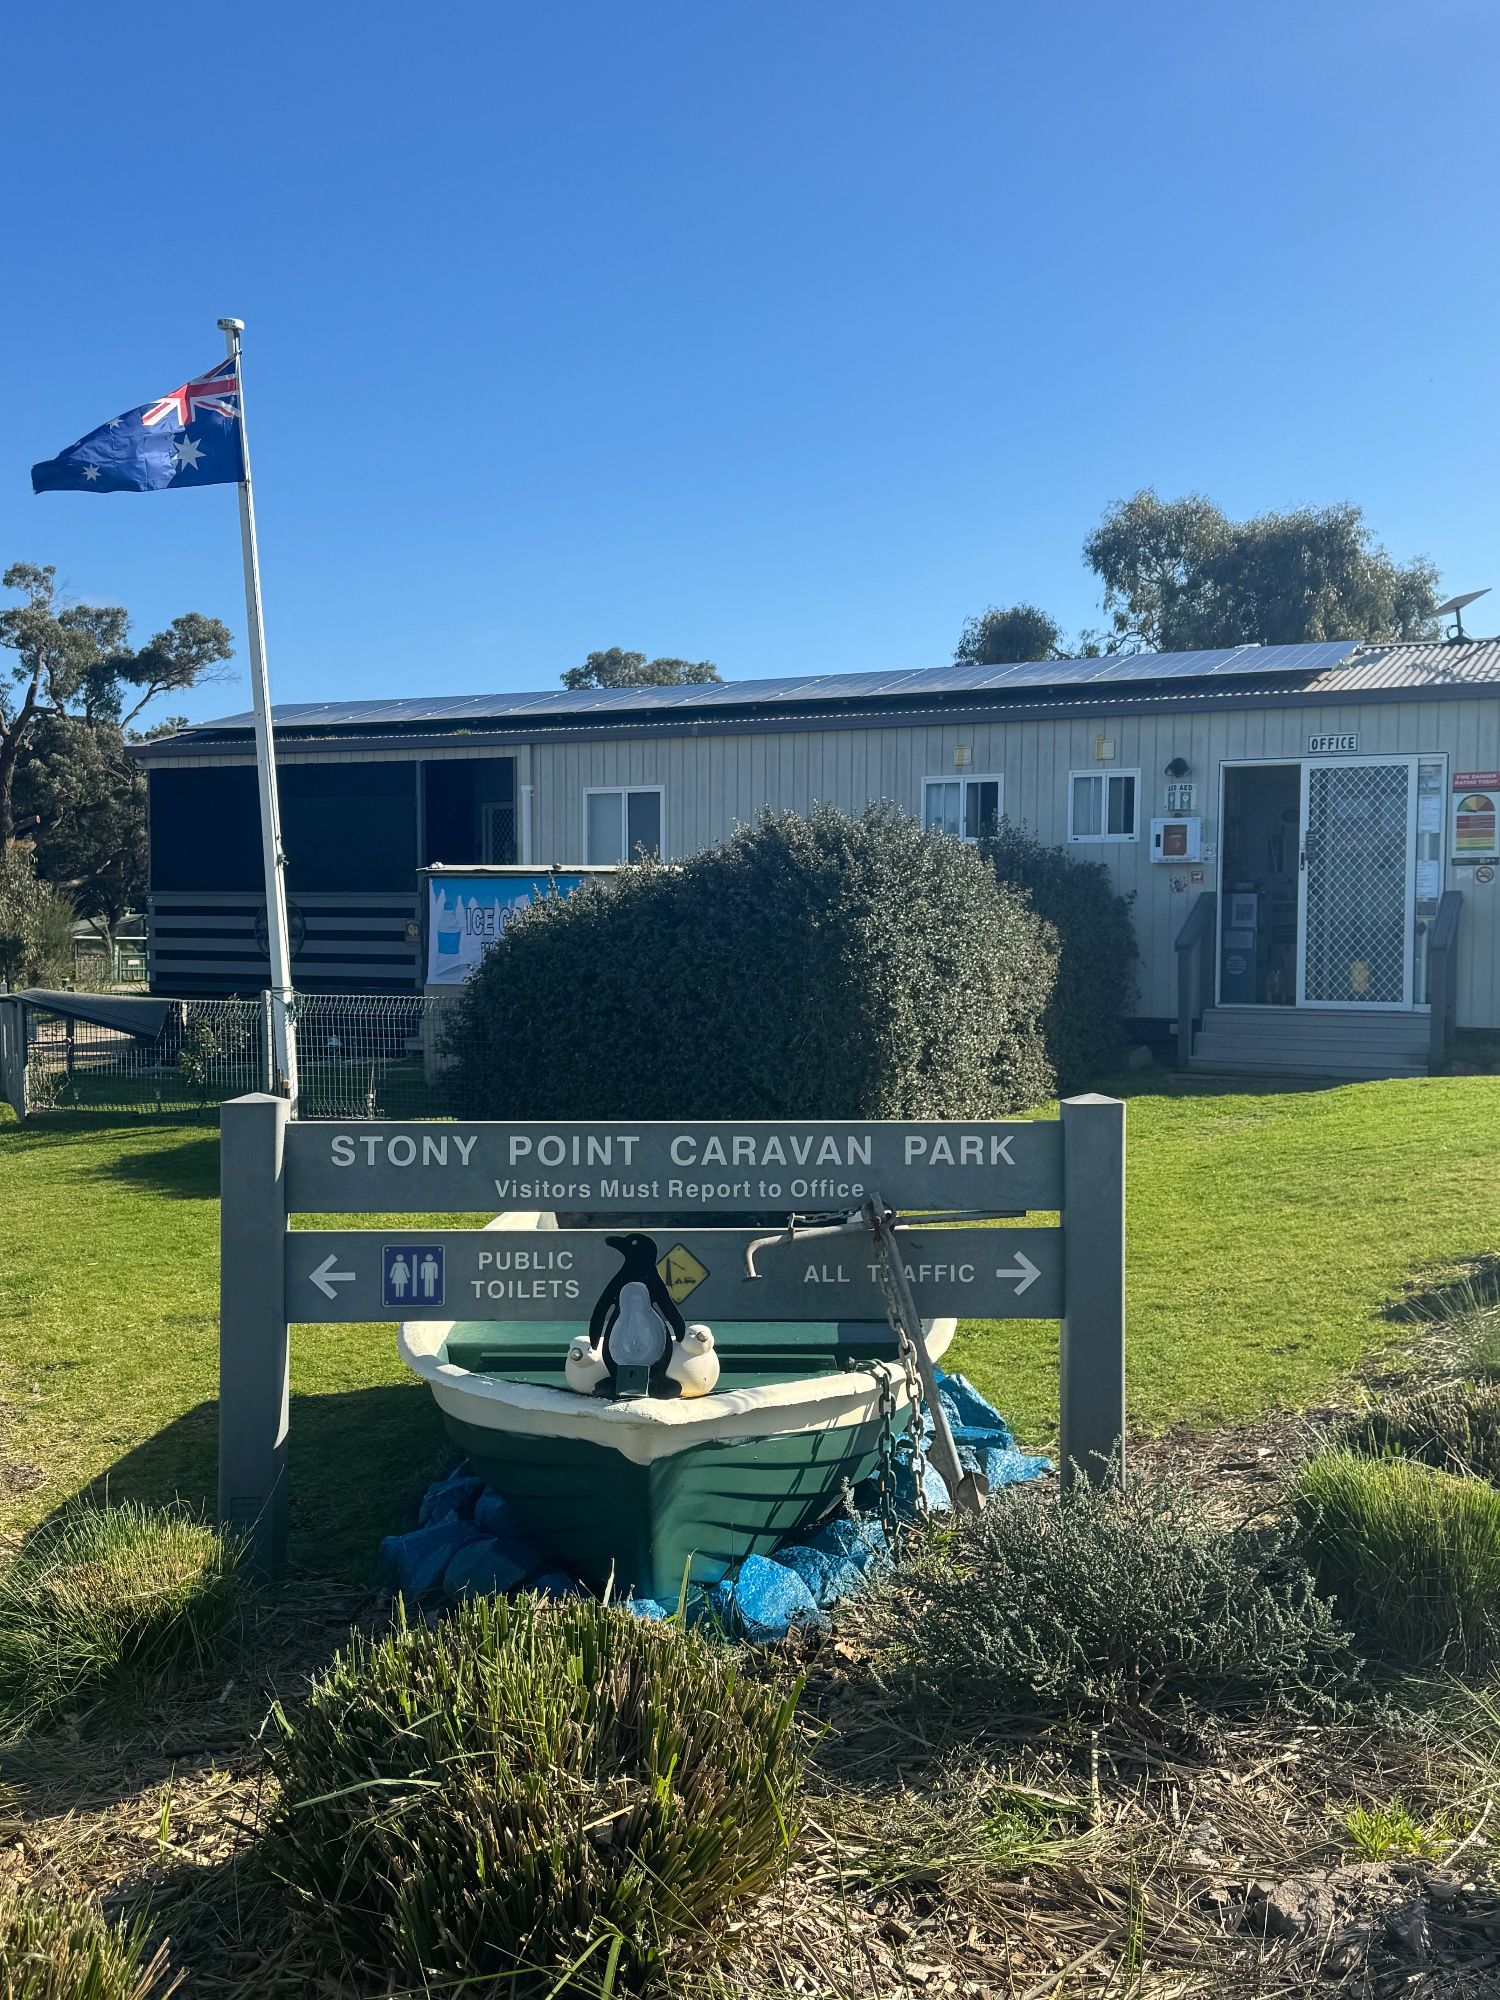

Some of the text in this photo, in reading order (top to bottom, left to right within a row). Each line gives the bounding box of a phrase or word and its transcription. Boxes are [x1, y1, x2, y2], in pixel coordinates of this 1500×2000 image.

[1311, 737, 1355, 750] OFFICE
[466, 907, 495, 936] ICE
[330, 1134, 1016, 1167] STONY POINT CARAVAN PARK
[495, 1178, 865, 1202] Visitors Must Report to Office
[478, 1251, 574, 1271] PUBLIC
[803, 1263, 975, 1283] ALL TAFFIC
[470, 1280, 580, 1300] TOILETS
